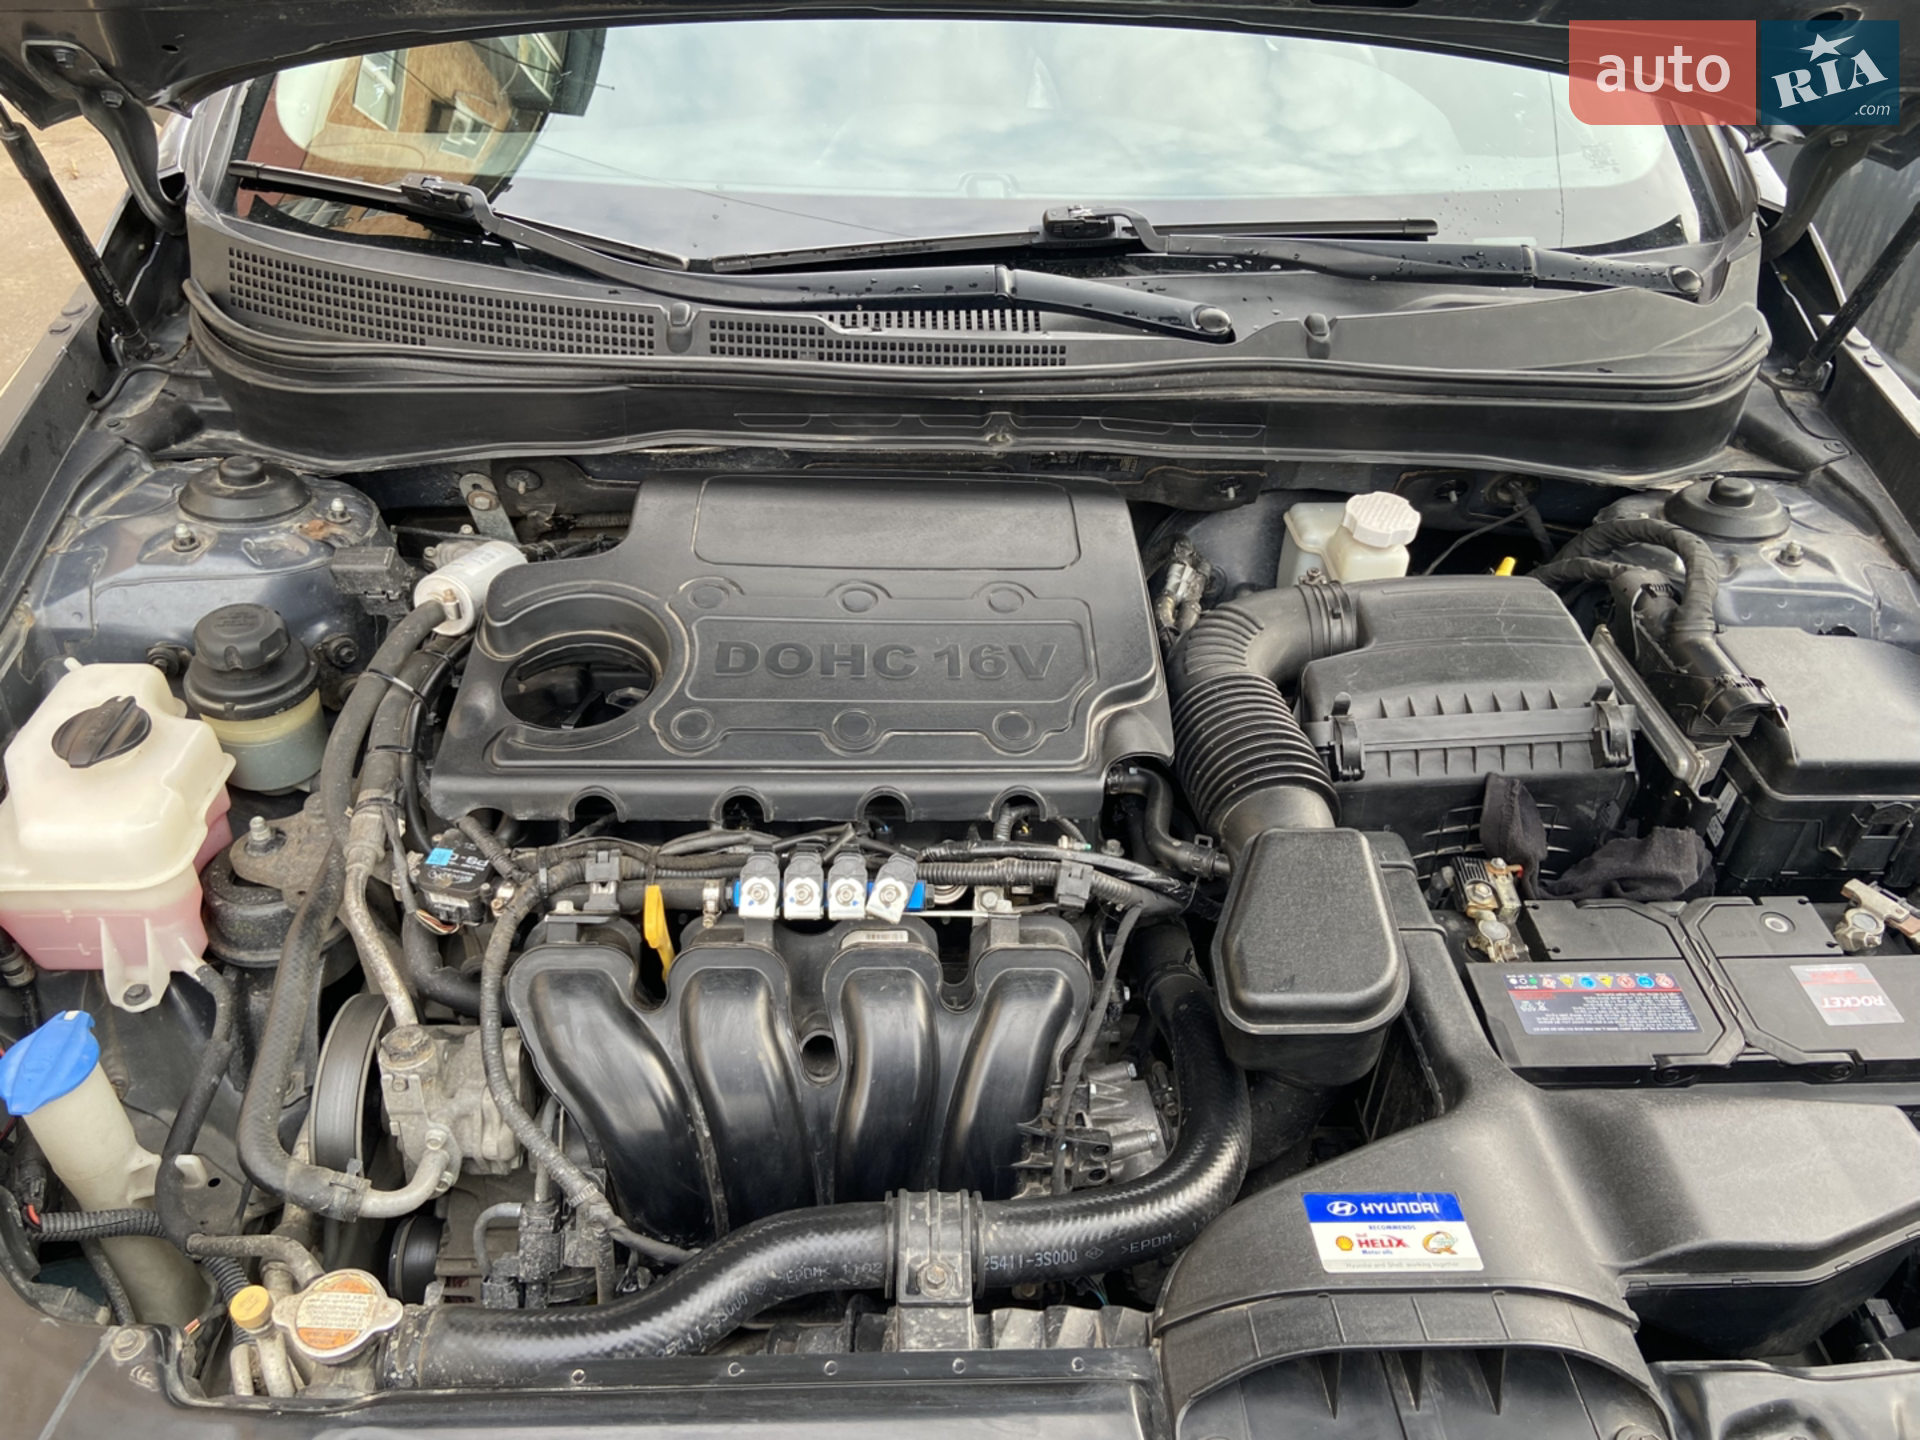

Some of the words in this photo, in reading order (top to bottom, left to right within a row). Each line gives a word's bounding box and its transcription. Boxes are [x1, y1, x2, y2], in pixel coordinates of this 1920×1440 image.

[713, 640, 919, 679] DOHC
[933, 642, 1058, 680] 16V
[1821, 994, 1887, 1009] ROCKET
[1361, 1201, 1440, 1215] HYUNDAI
[1357, 1238, 1407, 1248] HELIX
